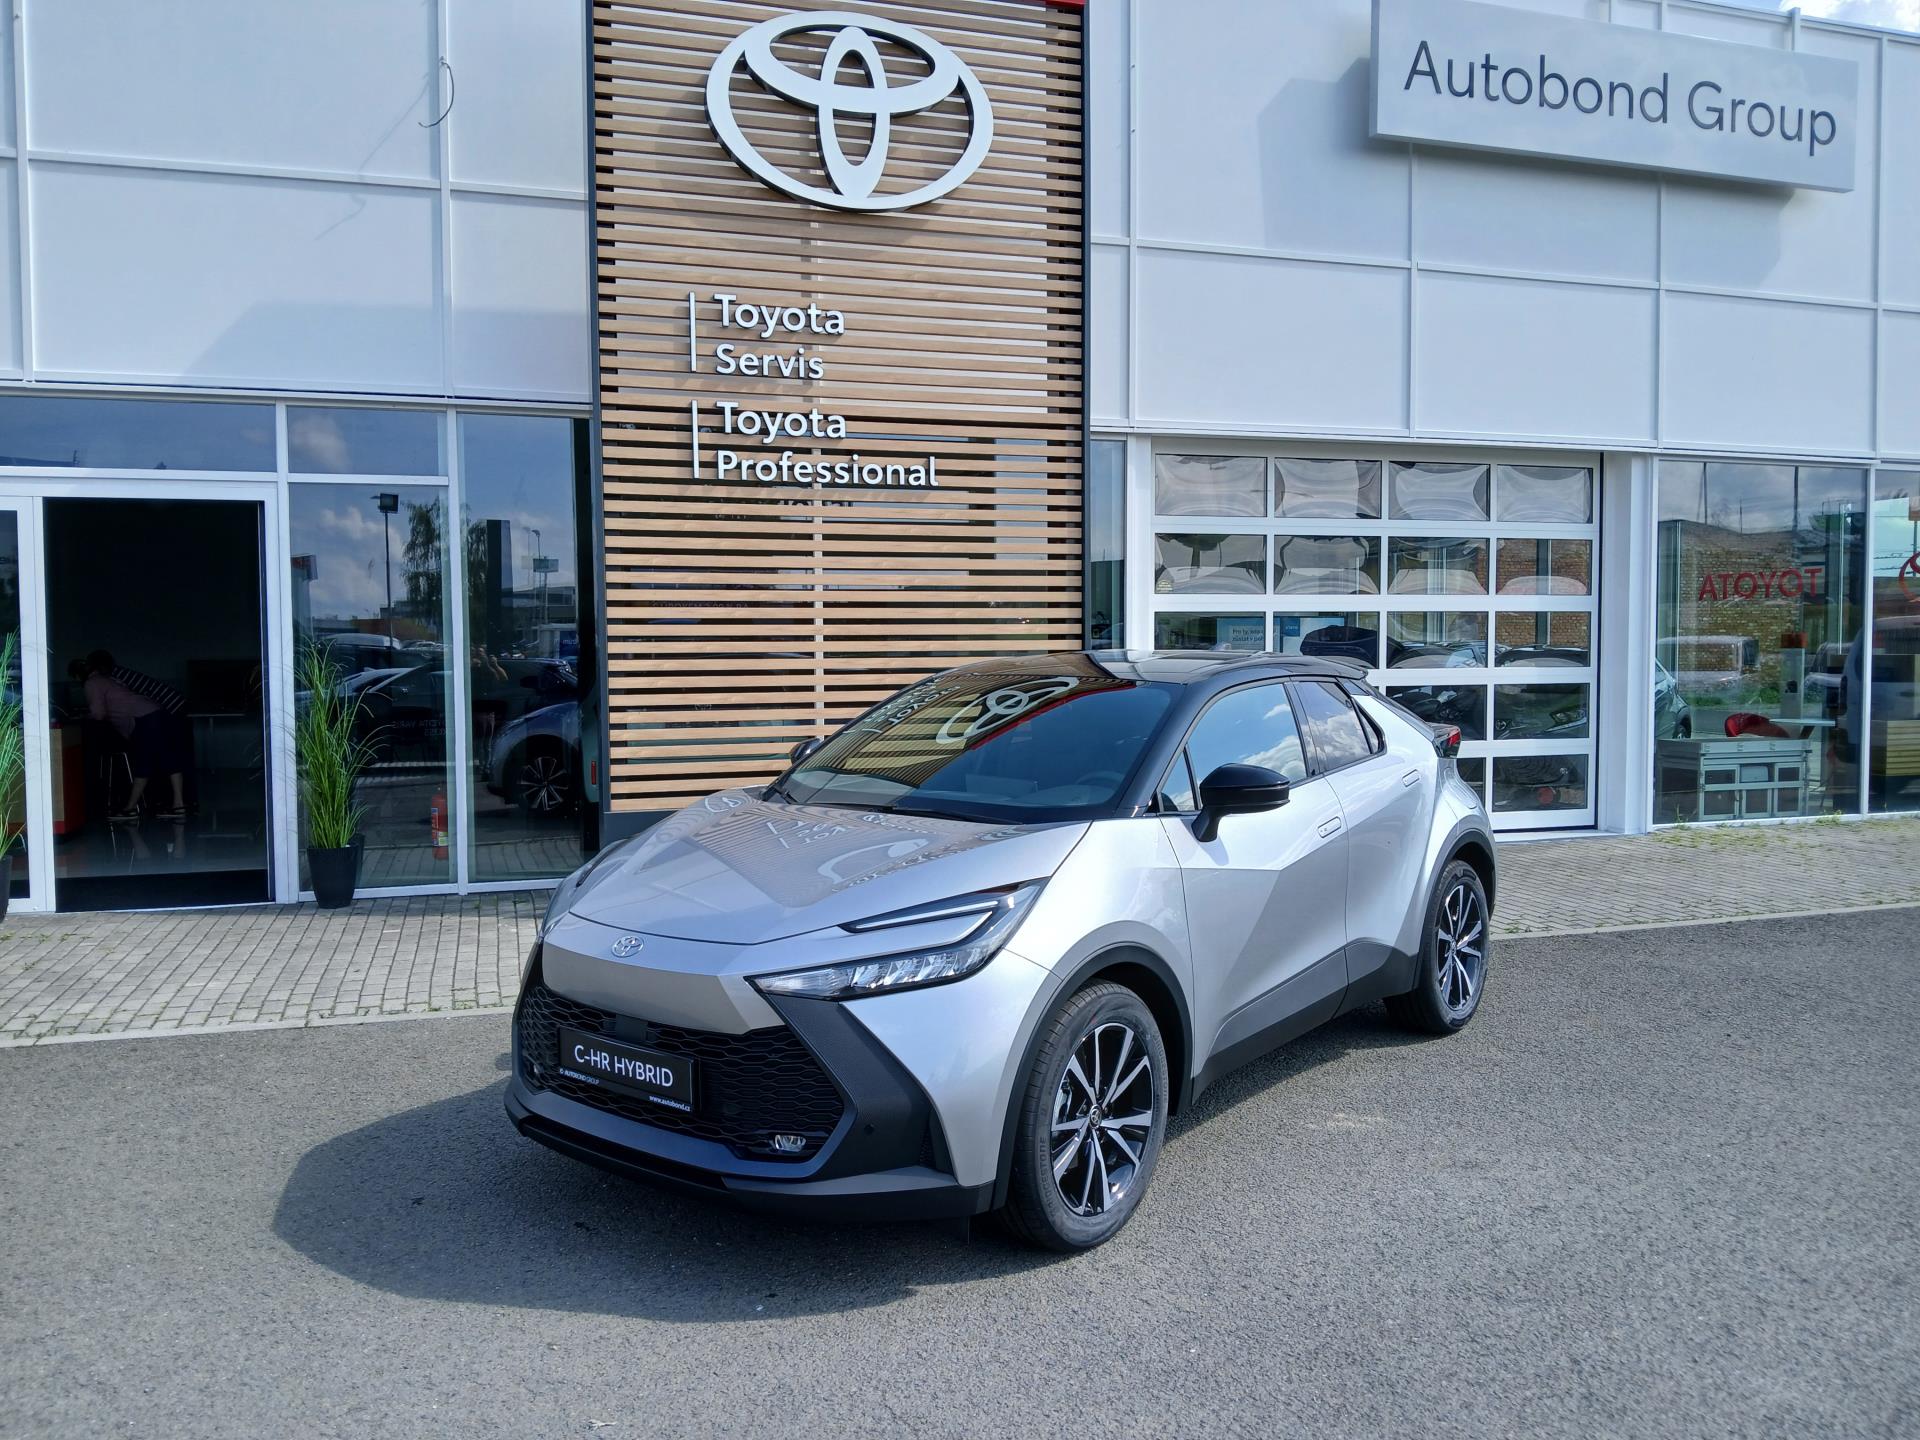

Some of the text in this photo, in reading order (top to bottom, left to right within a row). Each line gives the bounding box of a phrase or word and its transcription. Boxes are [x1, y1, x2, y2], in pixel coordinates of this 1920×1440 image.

[1404, 40, 1837, 157] Autobond Group
[713, 293, 846, 338] Toyota
[715, 343, 824, 379] Servis
[716, 400, 847, 444] Toyota
[716, 449, 939, 487] Professional
[574, 1044, 674, 1088] C-HR HYBRID
